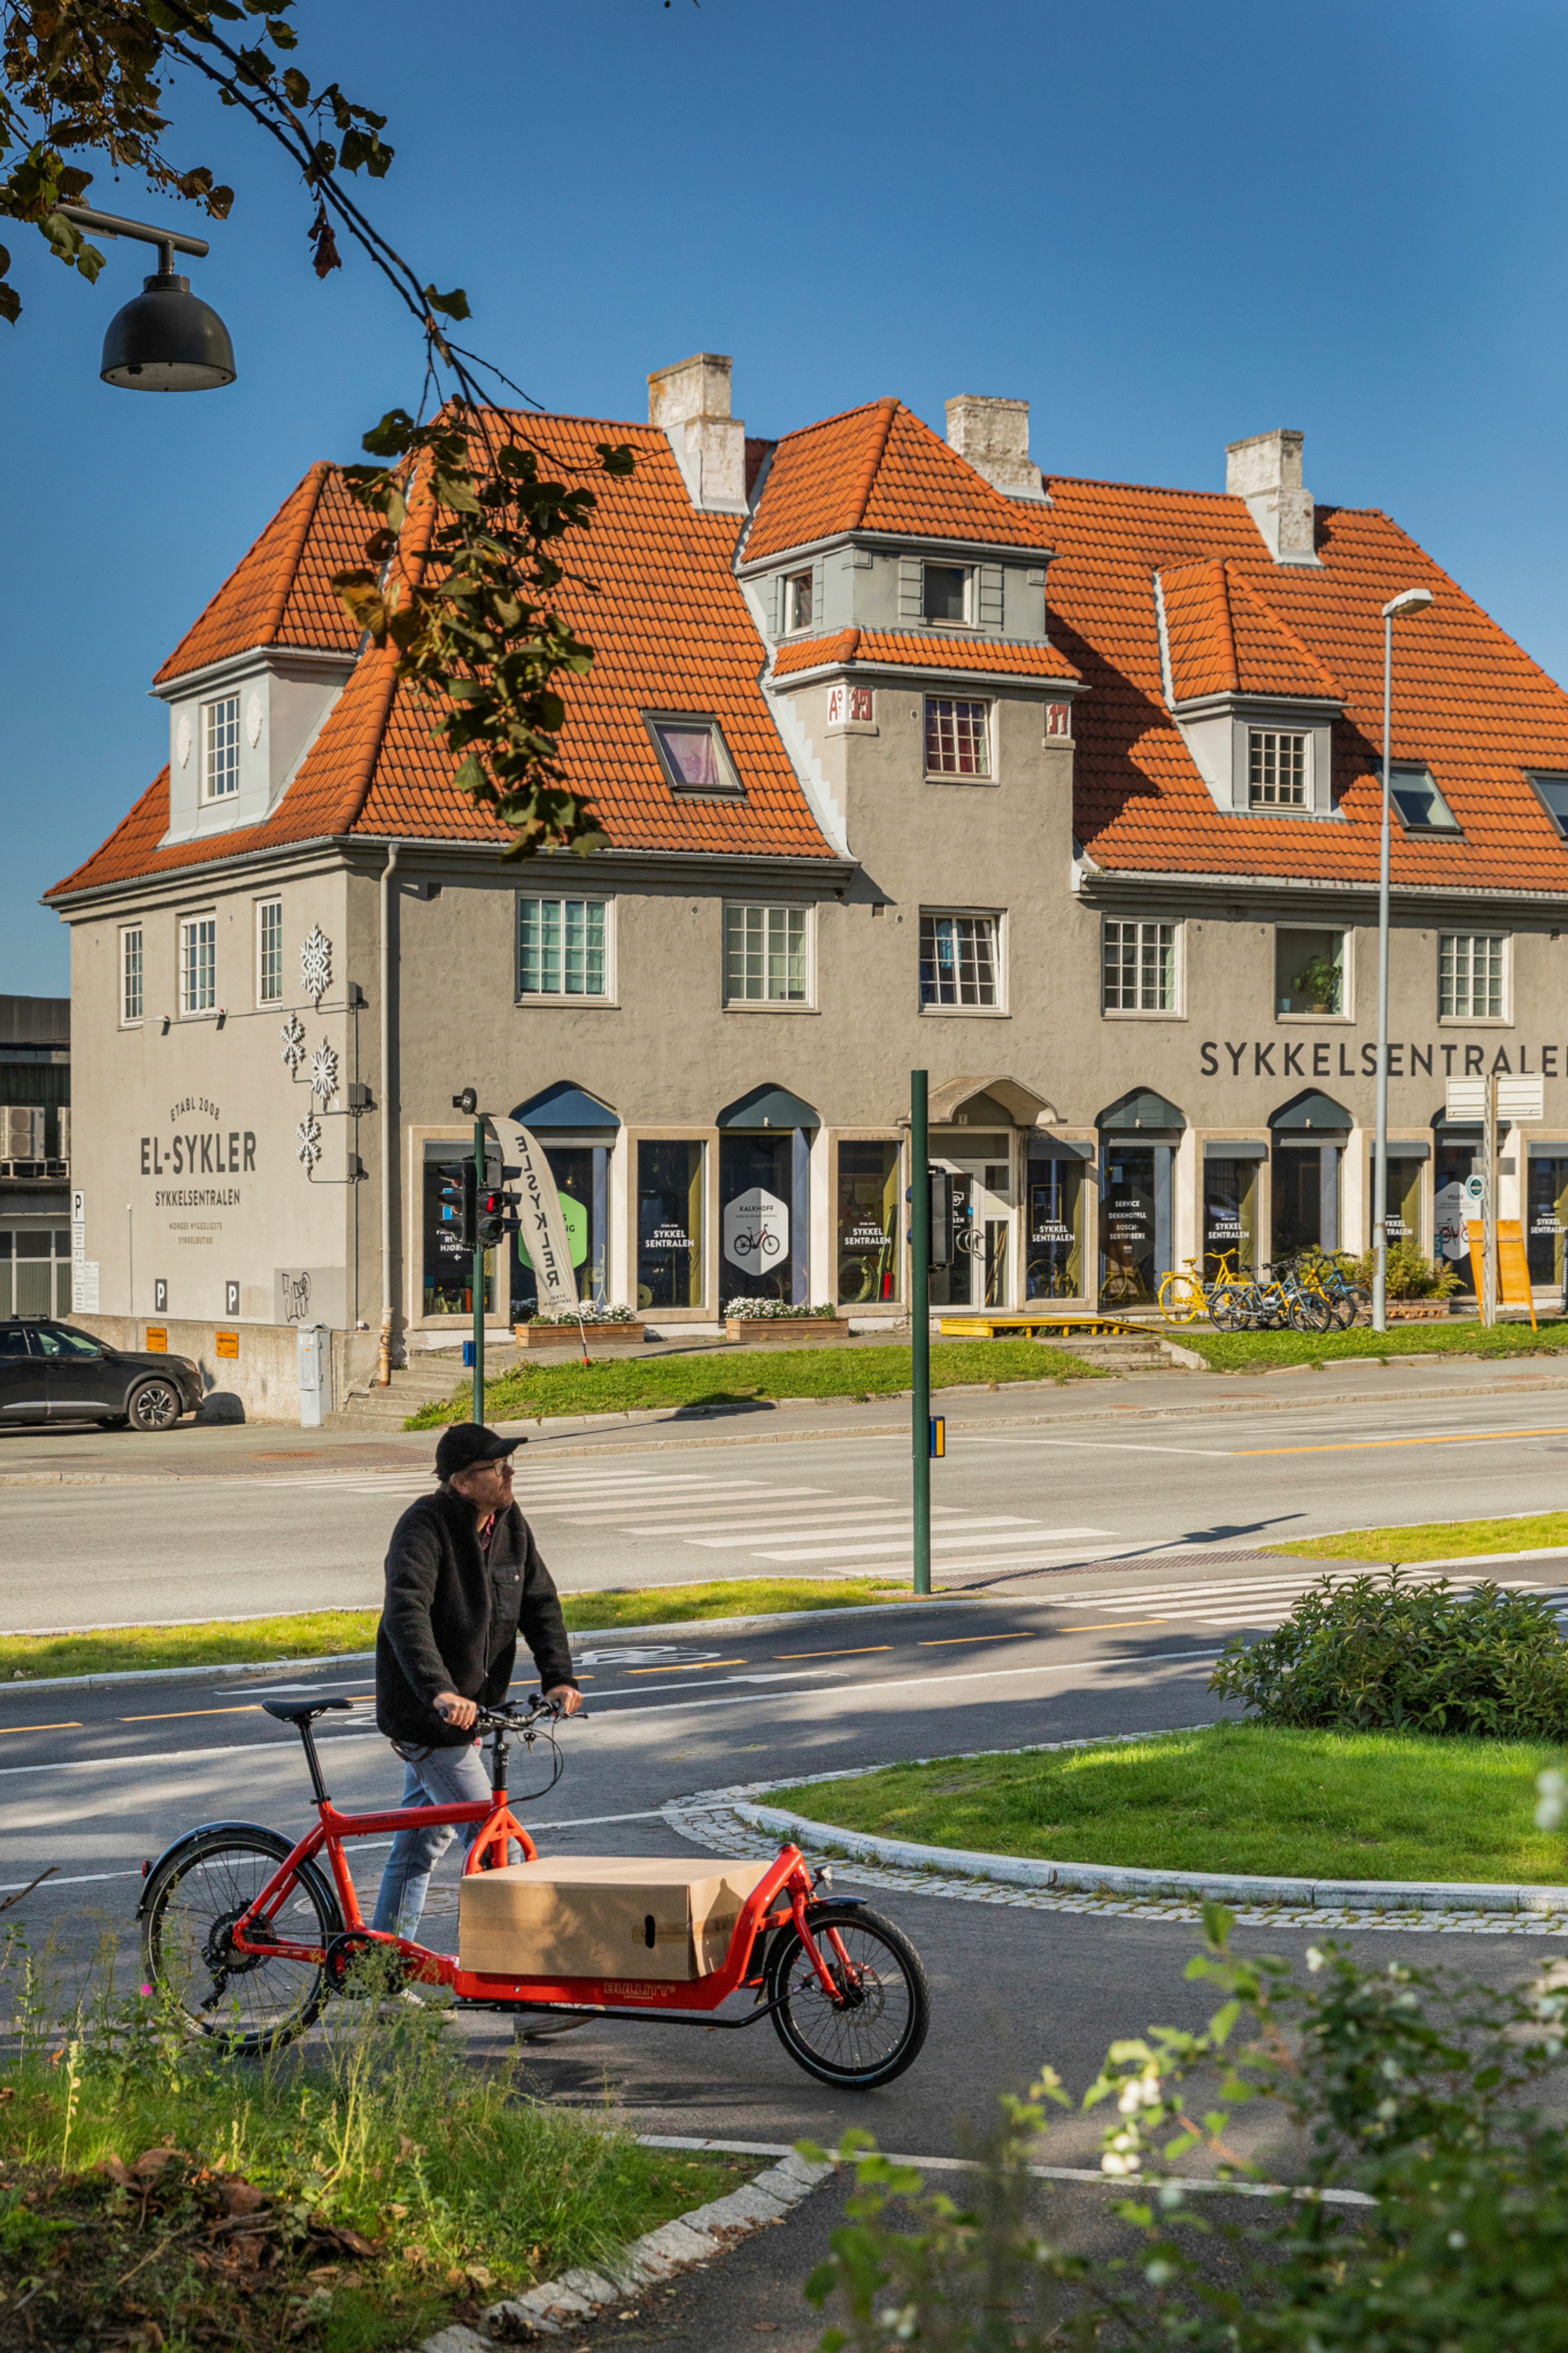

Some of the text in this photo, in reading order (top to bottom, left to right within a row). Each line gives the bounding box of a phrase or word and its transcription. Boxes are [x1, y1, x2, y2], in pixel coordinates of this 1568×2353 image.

[1200, 1041, 1568, 1077] SYKKELSENTRALE
[170, 1097, 220, 1122] ETABL 2008
[141, 1131, 256, 1175] EL-SYKLER
[76, 1194, 81, 1218] P
[155, 1189, 241, 1207] SYKKELSENTRALEN
[169, 1222, 223, 1230] NORGES HYGGELIGSTE
[653, 1230, 686, 1238] SYKKEL
[1208, 1231, 1250, 1239] SENTRALEN
[178, 1236, 213, 1244] SYKKELBUTIKK
[645, 1239, 695, 1248] SENTRALEN
[844, 1236, 891, 1245] SENTRALEN
[157, 1283, 165, 1307] P
[229, 1285, 237, 1311] P
